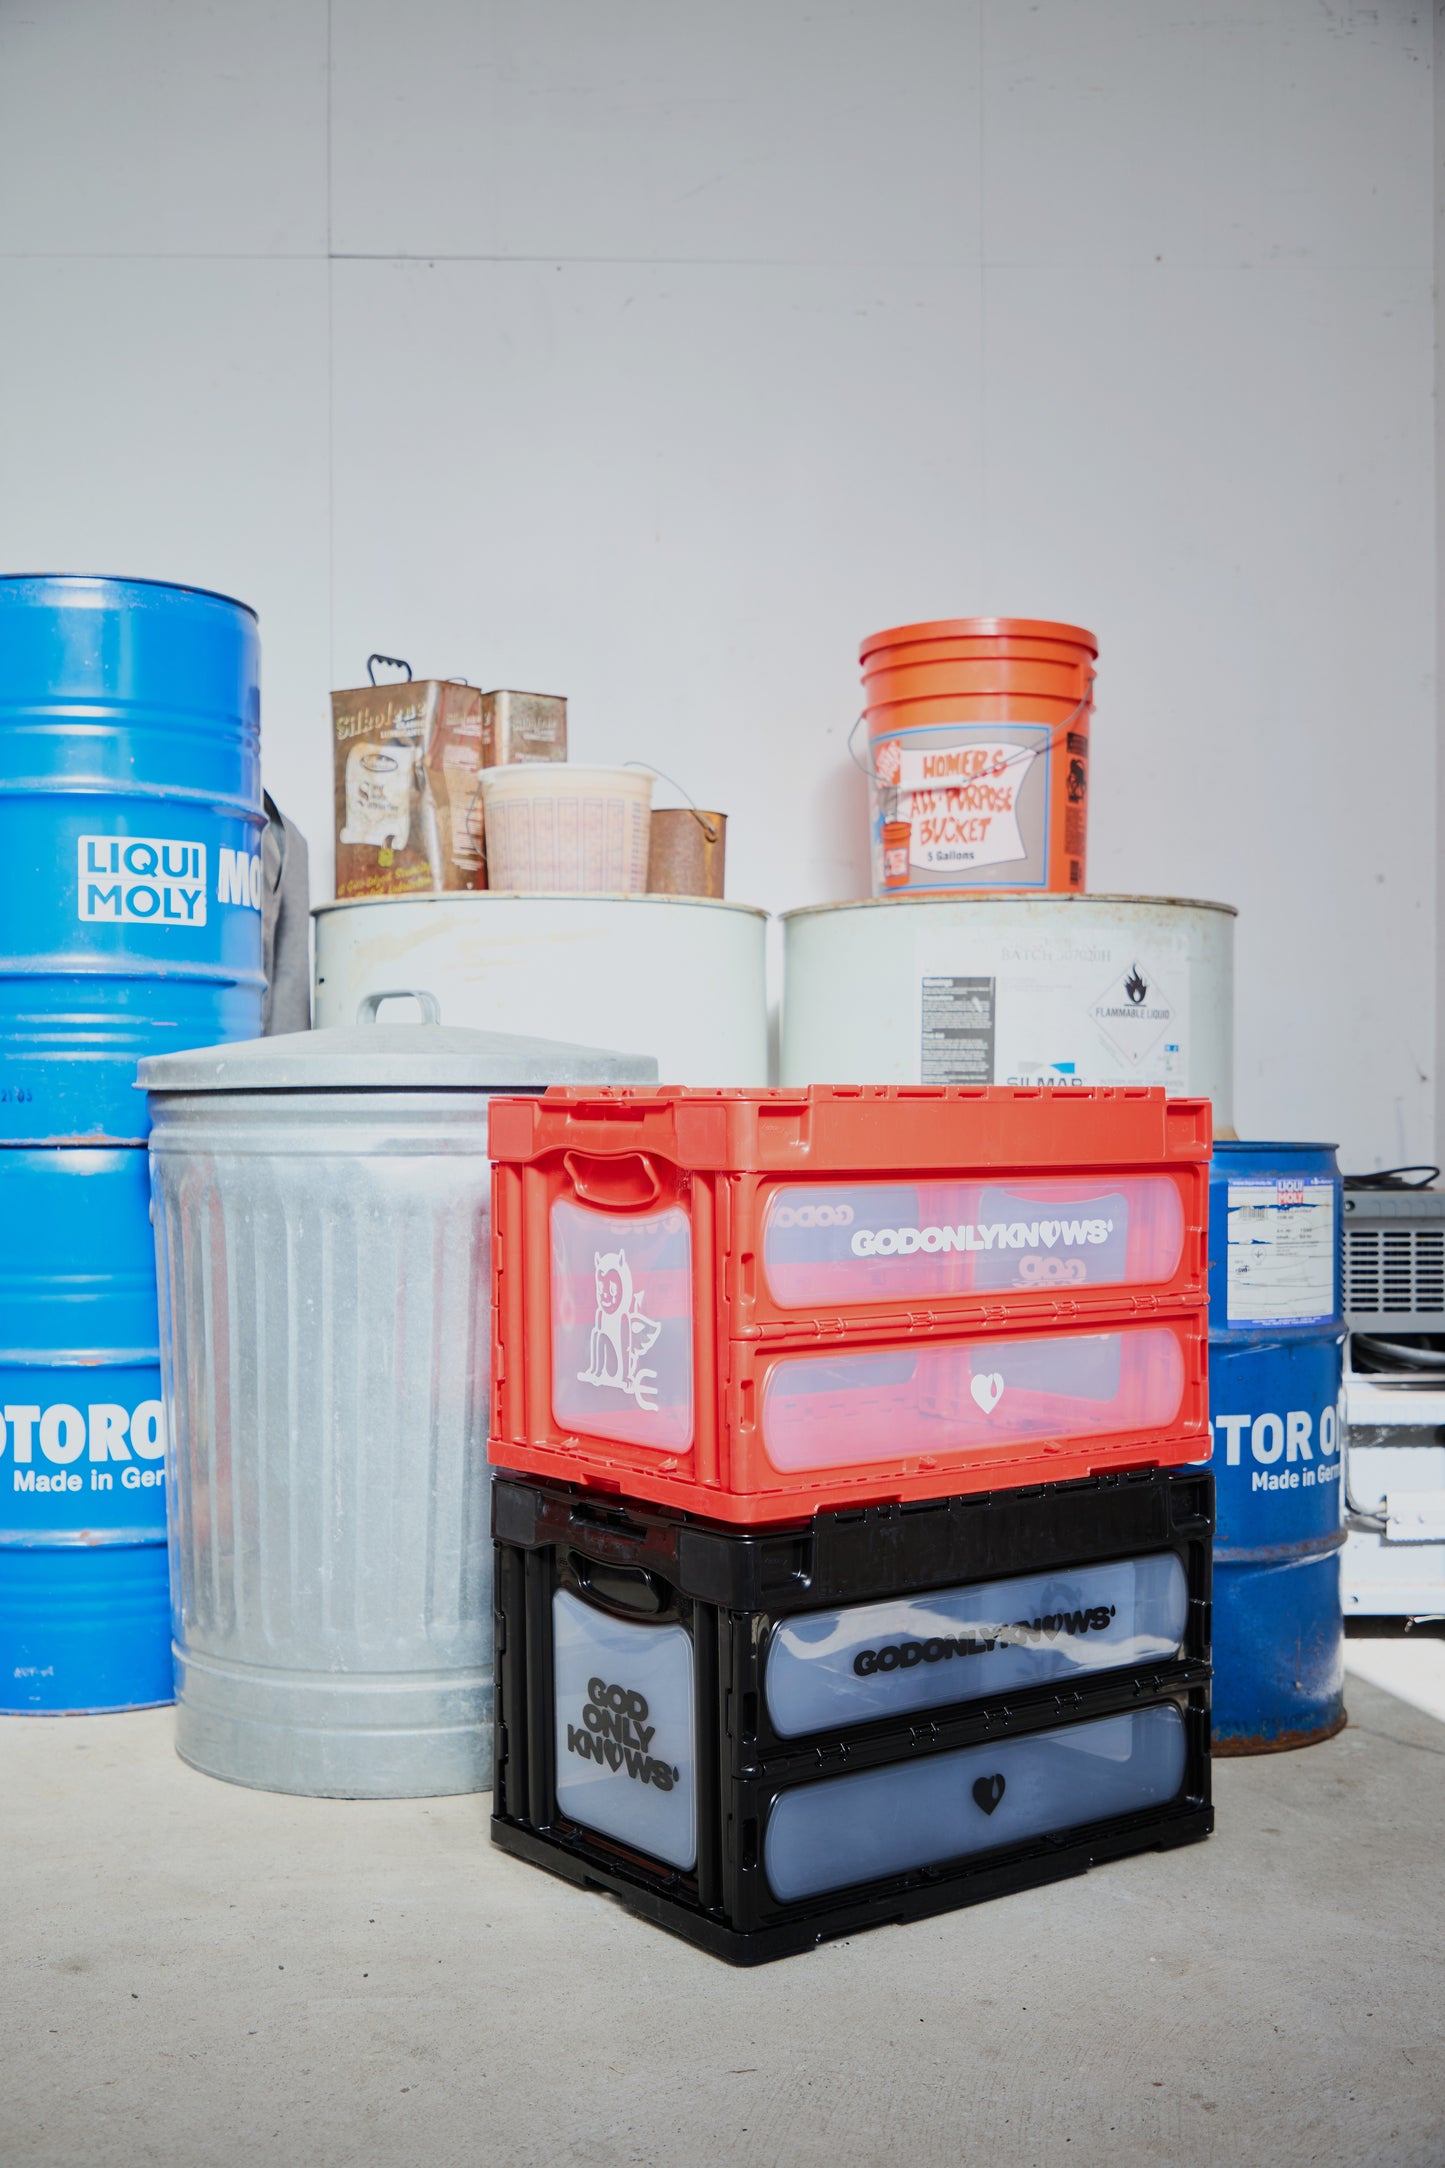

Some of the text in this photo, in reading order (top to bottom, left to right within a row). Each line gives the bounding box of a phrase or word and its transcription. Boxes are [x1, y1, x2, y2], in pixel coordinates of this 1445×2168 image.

[920, 816, 993, 846] BUCKET
[87, 841, 200, 879] LIQUI
[927, 850, 975, 862] 5 Gallons
[87, 884, 202, 920] MOLY
[1095, 1007, 1171, 1021] FLAMMABLE LIQUID
[1278, 1181, 1304, 1192] LIQUI
[1278, 1193, 1304, 1204] MOLY
[14, 1469, 83, 1492] Made
[91, 1469, 114, 1491] in
[1252, 1469, 1300, 1492] Made
[1302, 1467, 1316, 1487] in
[587, 1676, 649, 1722] GOD
[582, 1703, 656, 1754] ONLY
